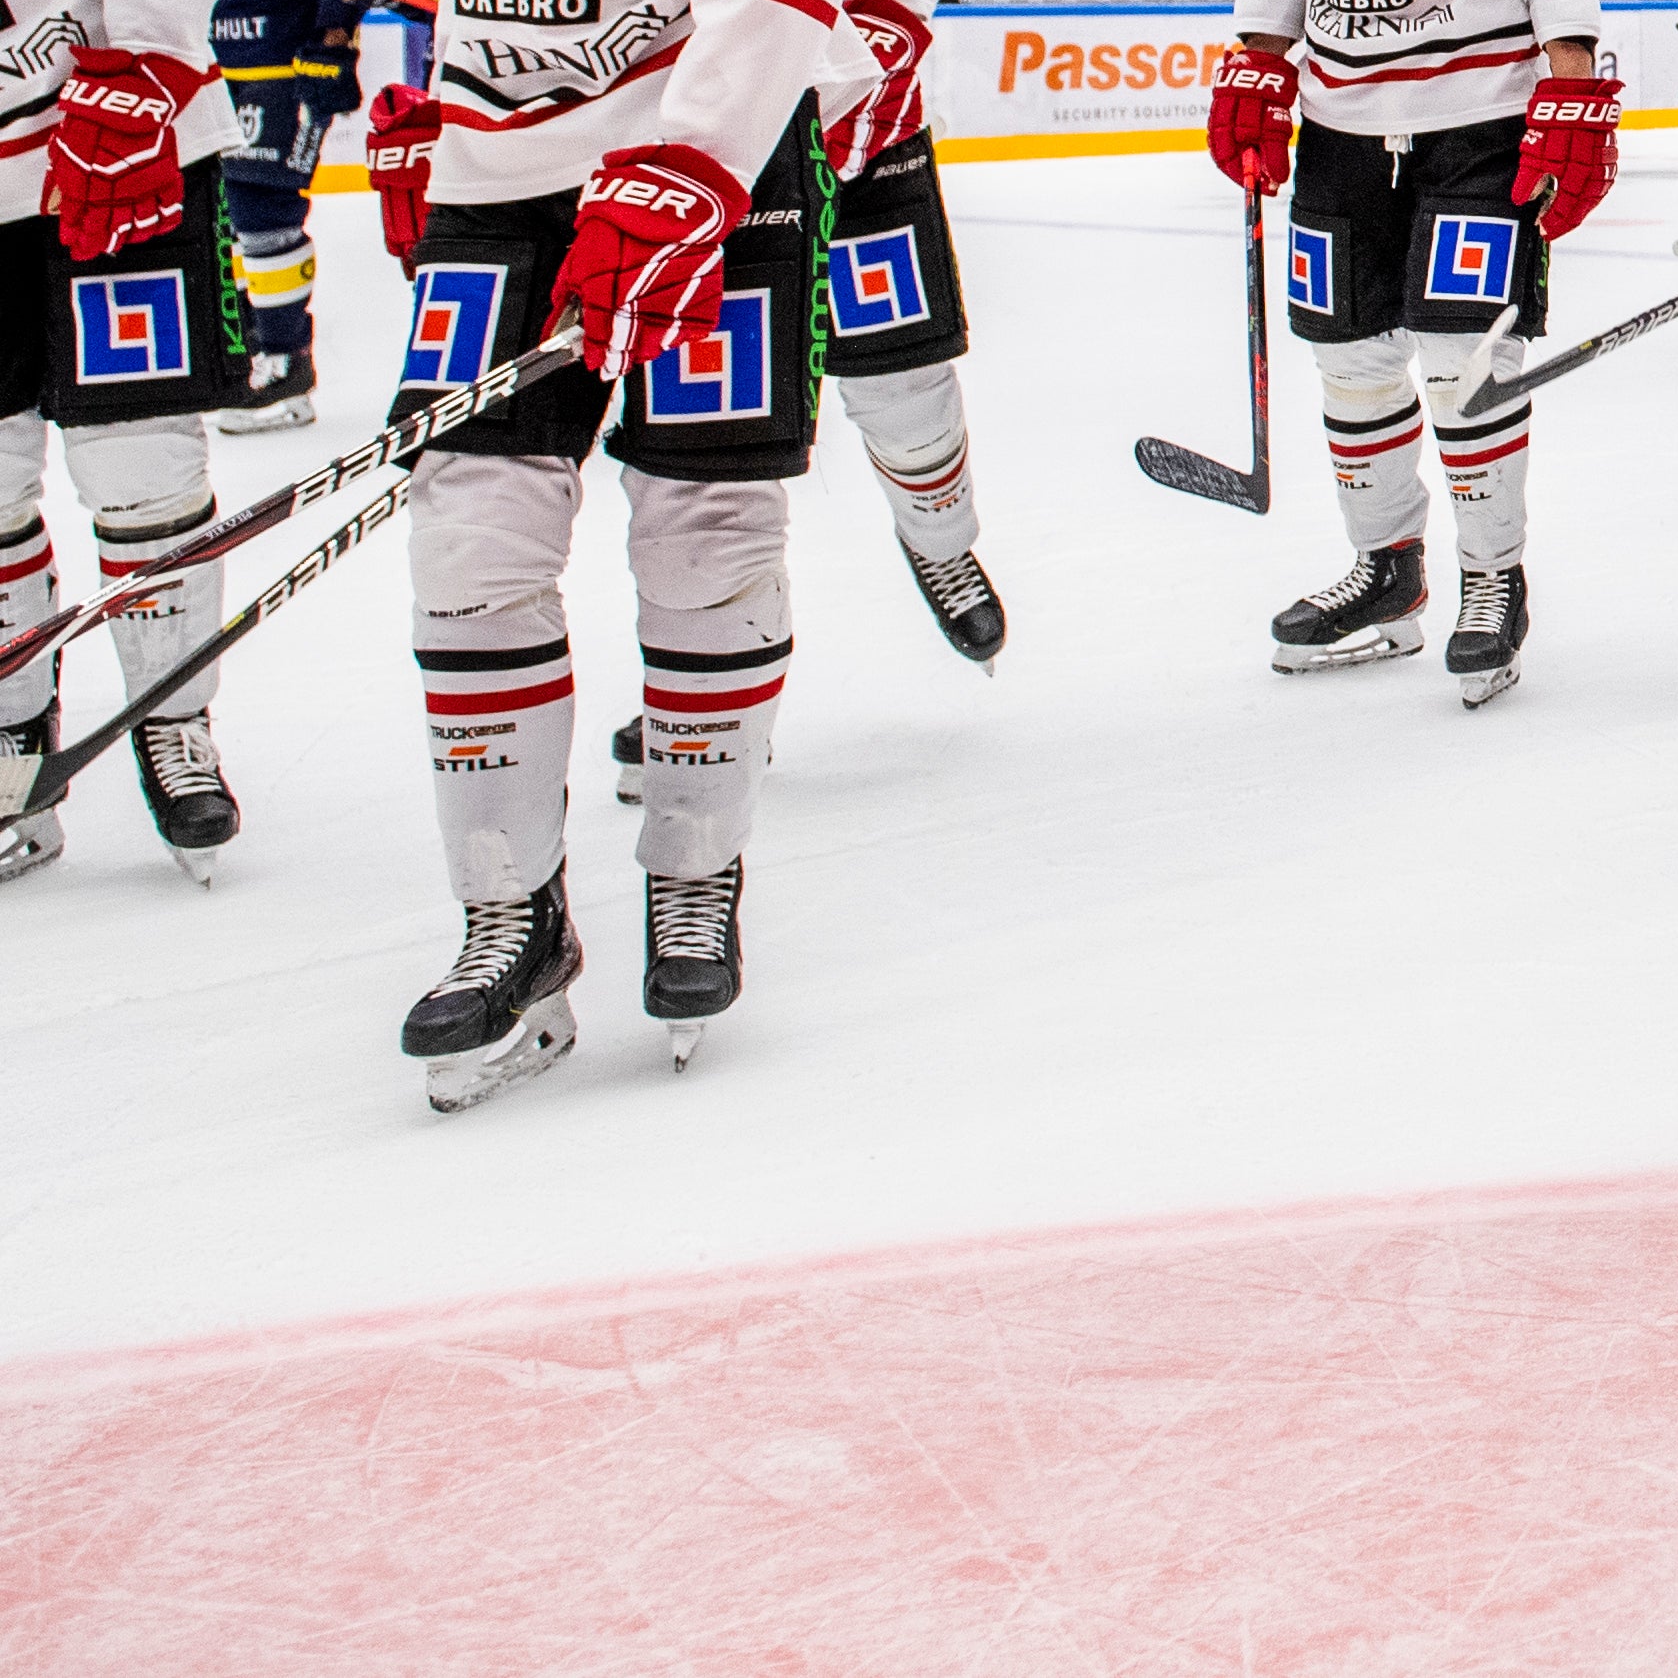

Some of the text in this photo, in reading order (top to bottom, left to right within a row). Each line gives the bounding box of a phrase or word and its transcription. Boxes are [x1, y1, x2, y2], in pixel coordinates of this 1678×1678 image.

[212, 15, 268, 41] HULT
[1052, 106, 1128, 122] SECURITY
[432, 754, 519, 772] STILL
[648, 750, 737, 767] STILL
